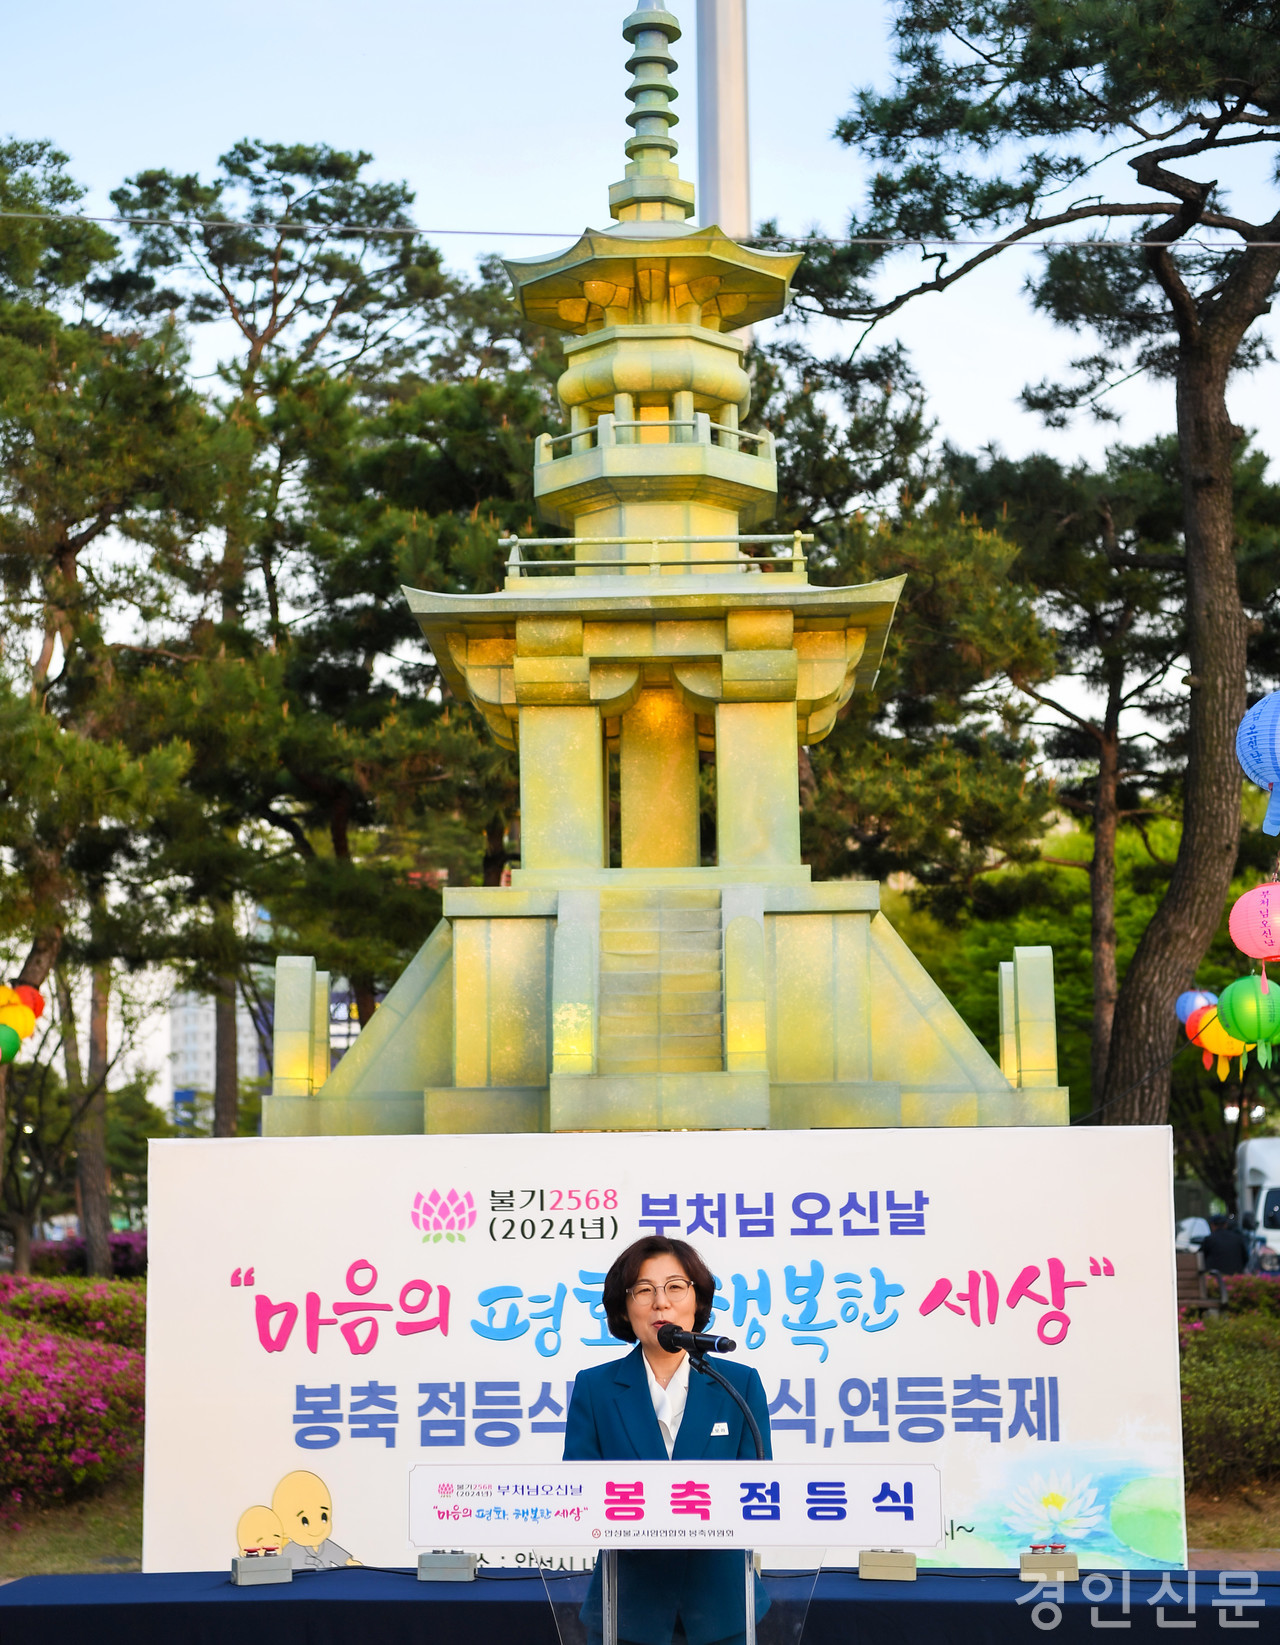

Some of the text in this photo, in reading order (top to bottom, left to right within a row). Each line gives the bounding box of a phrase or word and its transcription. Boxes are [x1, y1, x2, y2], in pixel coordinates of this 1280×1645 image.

[489, 1188, 619, 1212] 불기2568
[638, 1190, 930, 1237] 부처님 오신날
[488, 1215, 619, 1242] (2024년)
[292, 1380, 399, 1450] 봉축
[497, 1484, 583, 1497] 부처님오신날
